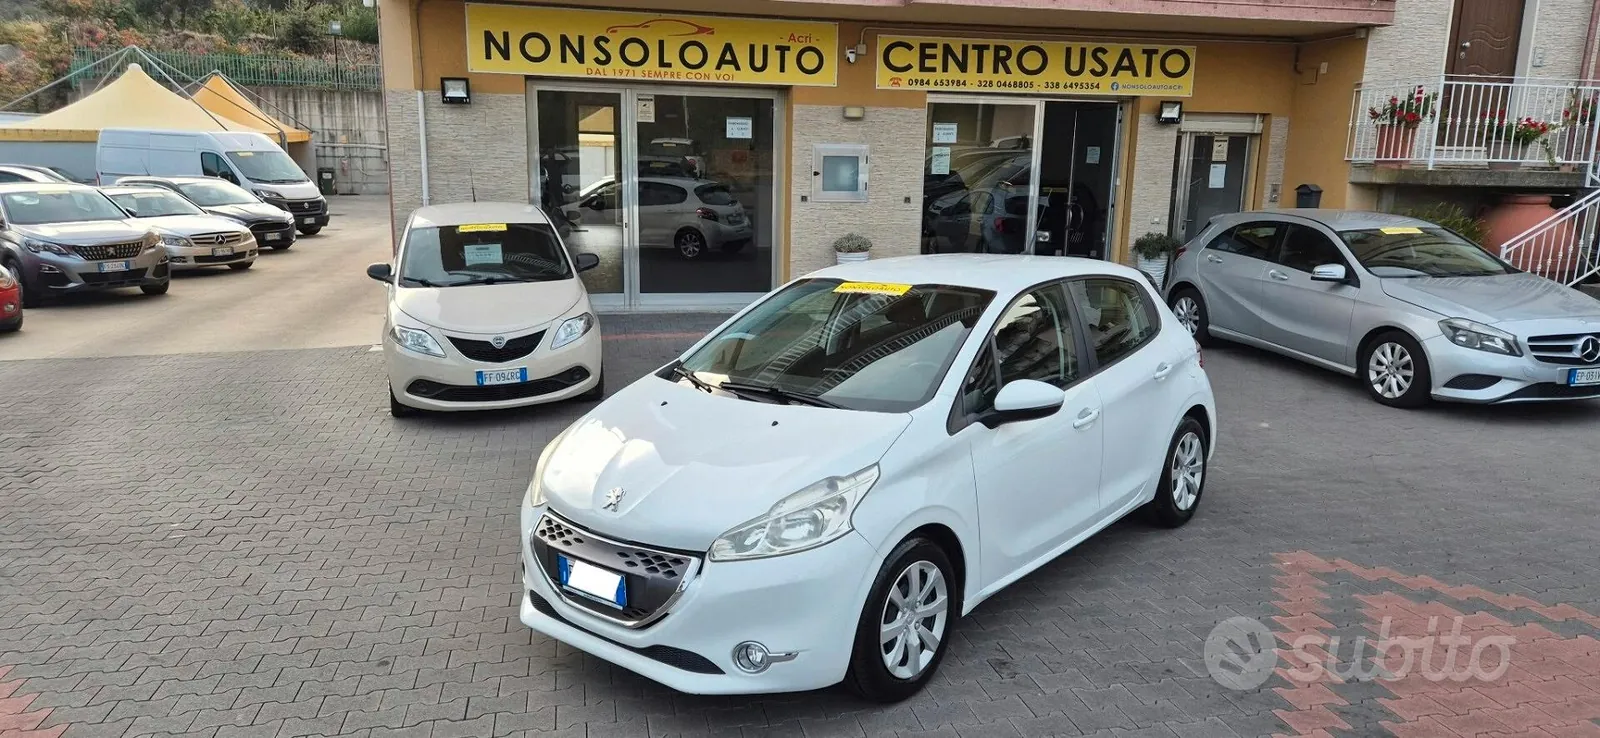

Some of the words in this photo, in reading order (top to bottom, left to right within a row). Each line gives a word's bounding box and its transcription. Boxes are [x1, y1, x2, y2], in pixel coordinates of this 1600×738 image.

[788, 32, 812, 44] Acri
[484, 30, 824, 75] NONSOLOAUTO
[883, 41, 1048, 76] CENTRO
[1065, 47, 1191, 79] USATO
[586, 67, 608, 76] DAL
[612, 68, 636, 77] 1971
[641, 69, 682, 80] SEMPRE
[685, 71, 711, 81] CON
[714, 73, 734, 82] VOI
[907, 78, 931, 87] 0984
[933, 78, 967, 88] 653984
[977, 79, 994, 88] 328
[996, 80, 1034, 89] 0468805
[1044, 81, 1060, 90] 338
[1063, 82, 1100, 91] 6495354
[484, 373, 494, 382] FF
